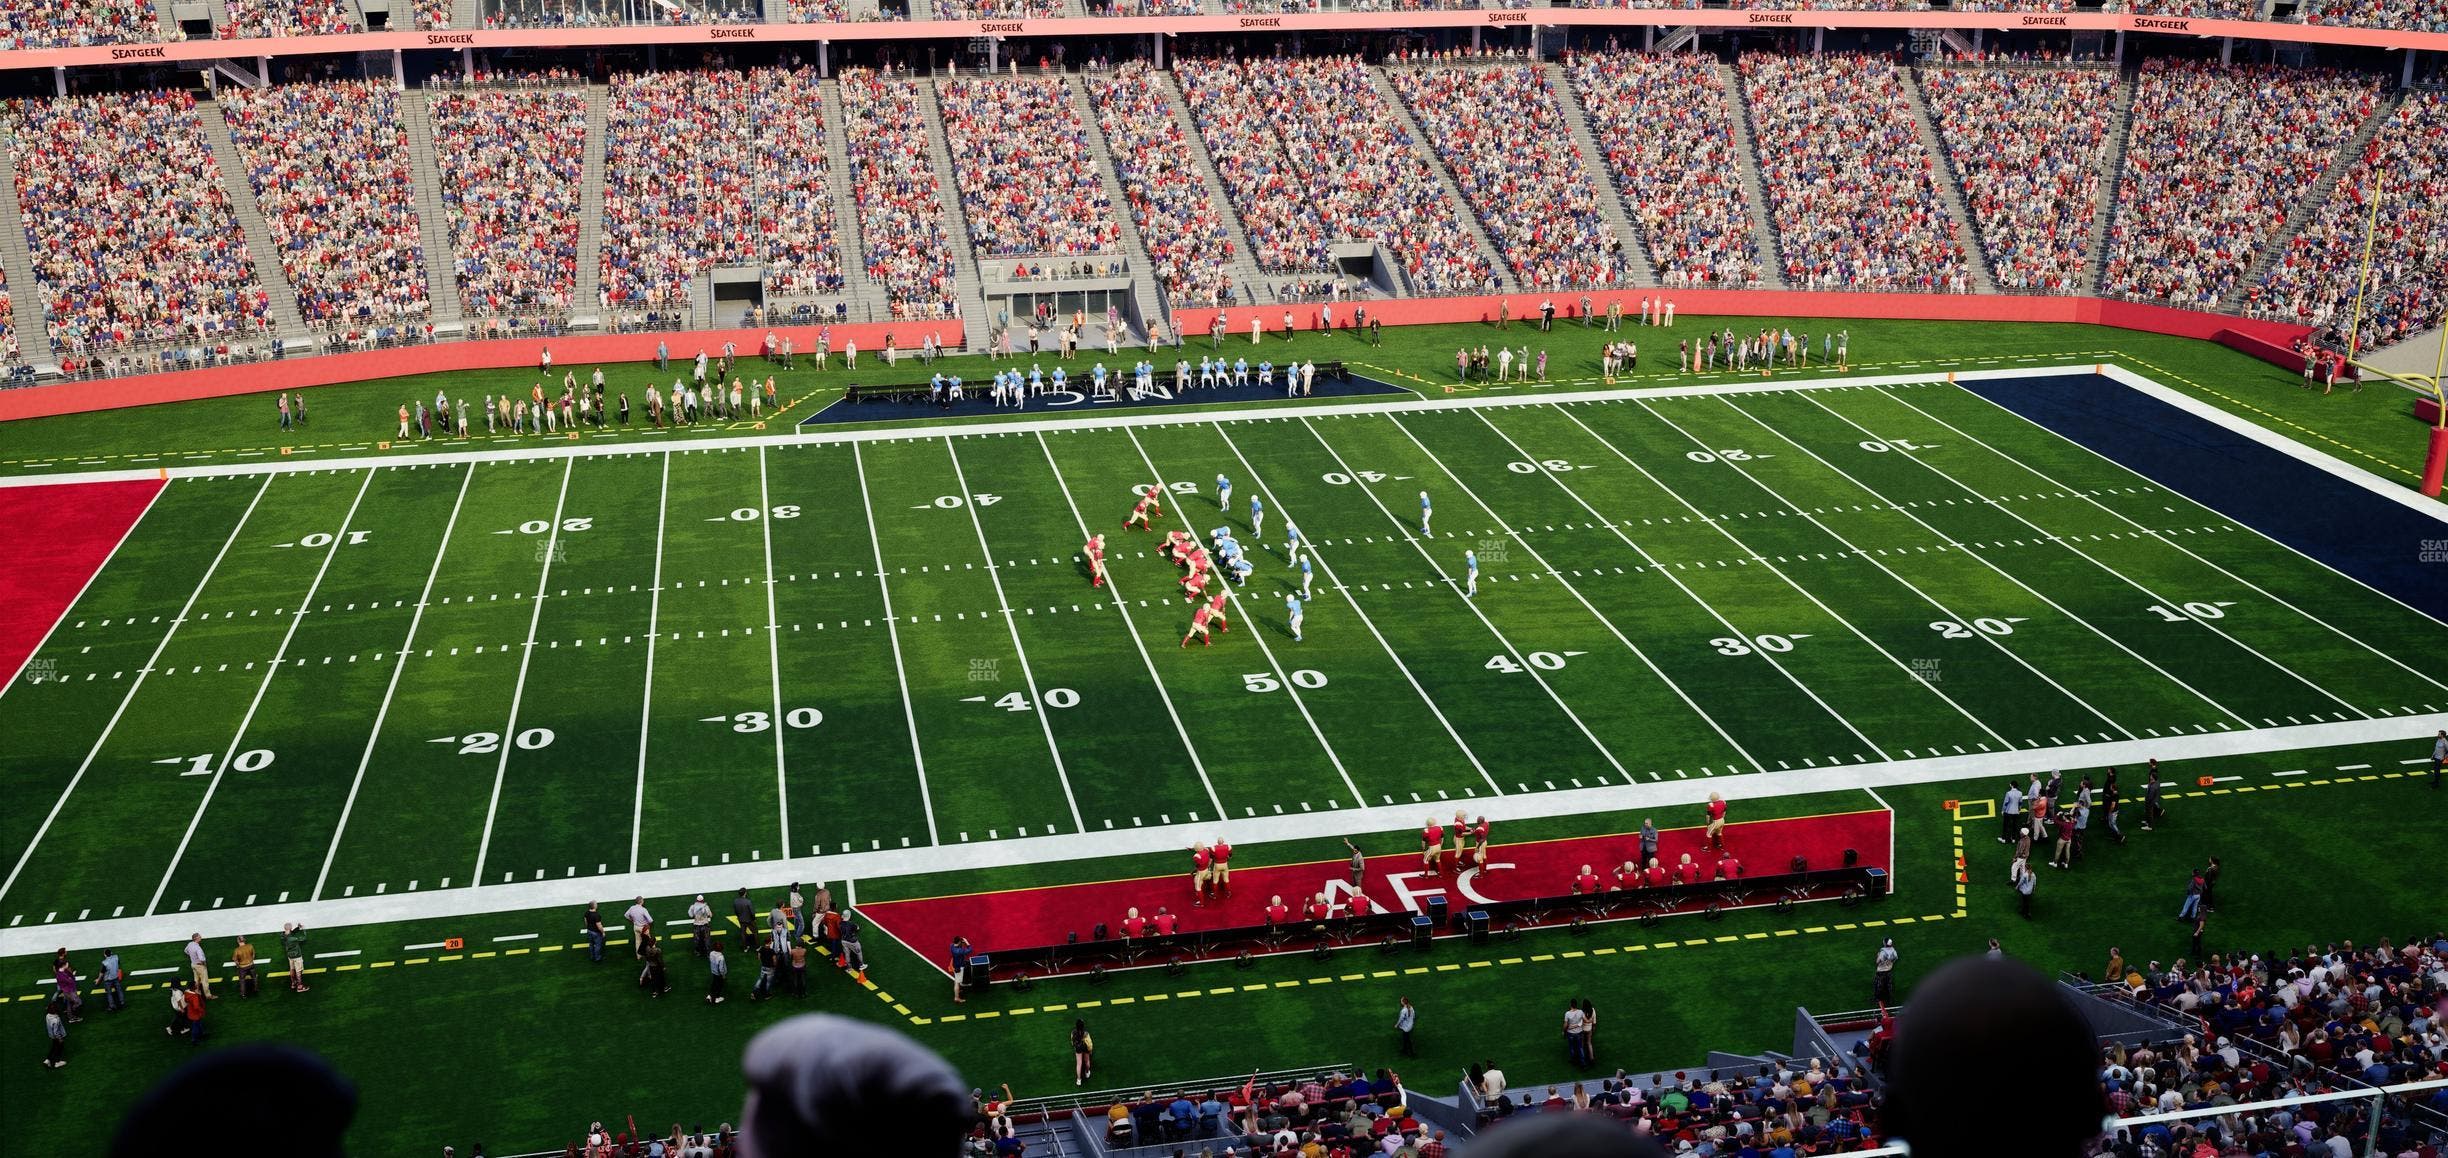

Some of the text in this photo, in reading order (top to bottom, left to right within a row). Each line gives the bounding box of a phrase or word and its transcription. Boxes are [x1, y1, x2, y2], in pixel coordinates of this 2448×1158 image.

[1240, 17, 1281, 27] SEATGEEK
[1488, 12, 1527, 22] SEATGEEK
[1749, 13, 1793, 23] SEATGEEK
[2022, 16, 2067, 26] SEATGEEK
[981, 23, 1024, 33] SEATGEEK
[2134, 18, 2189, 31] SEATGEEK
[427, 34, 474, 45] SEATGEEK
[710, 28, 755, 38] SEATGEEK
[112, 47, 166, 59] SEATGEEK
[1859, 439, 1921, 452] 10
[1686, 450, 1753, 463] 20
[1507, 460, 1574, 473] 30
[1322, 471, 1388, 485] 40
[1131, 482, 1199, 496] 50
[935, 494, 1003, 508] 40
[731, 505, 801, 520] 30
[519, 517, 594, 534] 20
[300, 530, 372, 547] 10
[2146, 602, 2225, 621] 10
[1929, 618, 2014, 639] 20
[1709, 634, 1794, 656] 30
[1484, 651, 1567, 673] 40
[1243, 669, 1328, 692] 50
[994, 688, 1081, 711] 40
[733, 707, 824, 732] 30
[458, 728, 555, 754] 20
[180, 749, 275, 776] 10
[1324, 863, 1515, 919] AFC
